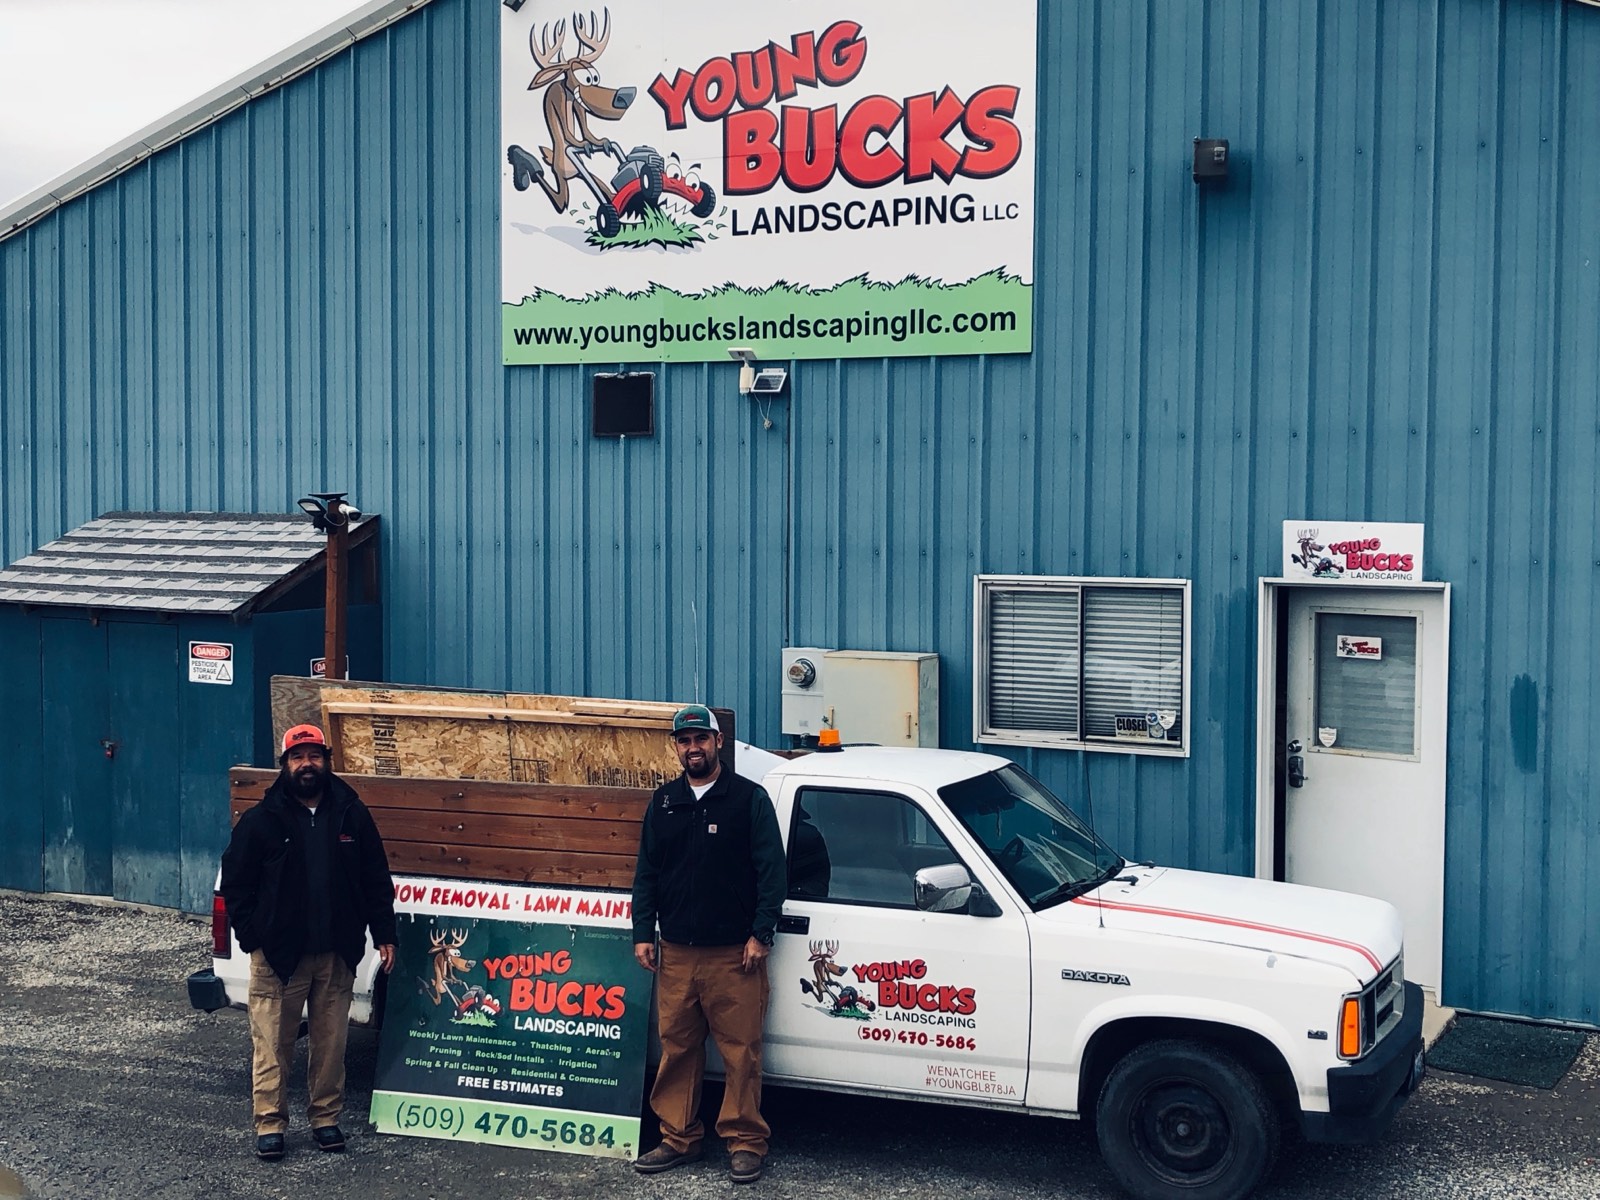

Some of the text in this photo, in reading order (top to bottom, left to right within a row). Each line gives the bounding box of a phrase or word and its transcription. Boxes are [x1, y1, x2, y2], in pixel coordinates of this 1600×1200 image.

[648, 20, 867, 131] YOUNG
[723, 85, 1022, 196] BUCKS
[731, 193, 1019, 237] LANDSCAPING LLC
[513, 308, 1017, 350] www.youngbuckslandscapingllc.com
[1328, 537, 1381, 555] YOUNG
[1346, 552, 1414, 572] BUCKS
[1350, 571, 1413, 581] LANDSCAPING
[196, 647, 226, 657] DANGER
[191, 660, 218, 668] PESTICIDE
[193, 667, 217, 675] STORAGE
[1116, 718, 1148, 731] CLOSED
[430, 887, 511, 910] REMOVAL
[523, 894, 572, 914] LAWN
[482, 949, 572, 980] YOUNG
[852, 959, 927, 983] YOUNG
[1061, 968, 1131, 986] DAKOTA
[509, 978, 626, 1020] BUCKS
[878, 980, 977, 1015] BUCKS
[514, 1016, 622, 1040] LANDSCAPING
[885, 1010, 977, 1029] LANDSCAPING
[409, 1030, 440, 1040] Weekly
[441, 1032, 464, 1042] Lawn
[465, 1035, 517, 1047] Maintenance
[530, 1041, 572, 1054] Thatching
[429, 1045, 598, 1070] Pruning Rock/Sod Installs Irrigation
[405, 1057, 433, 1068] Spring
[434, 1060, 441, 1068] &
[444, 1061, 460, 1070] Fall
[461, 1063, 485, 1072] Clean
[487, 1065, 498, 1075] Up
[511, 1068, 557, 1080] Residential
[568, 1074, 619, 1086] Commercial
[927, 1064, 997, 1082] WENATCHEE
[457, 1075, 564, 1097] FREE ESTIMATES
[925, 1077, 1017, 1096] #YOUNGBL878JA
[396, 1101, 615, 1149] (509) 470-5684
